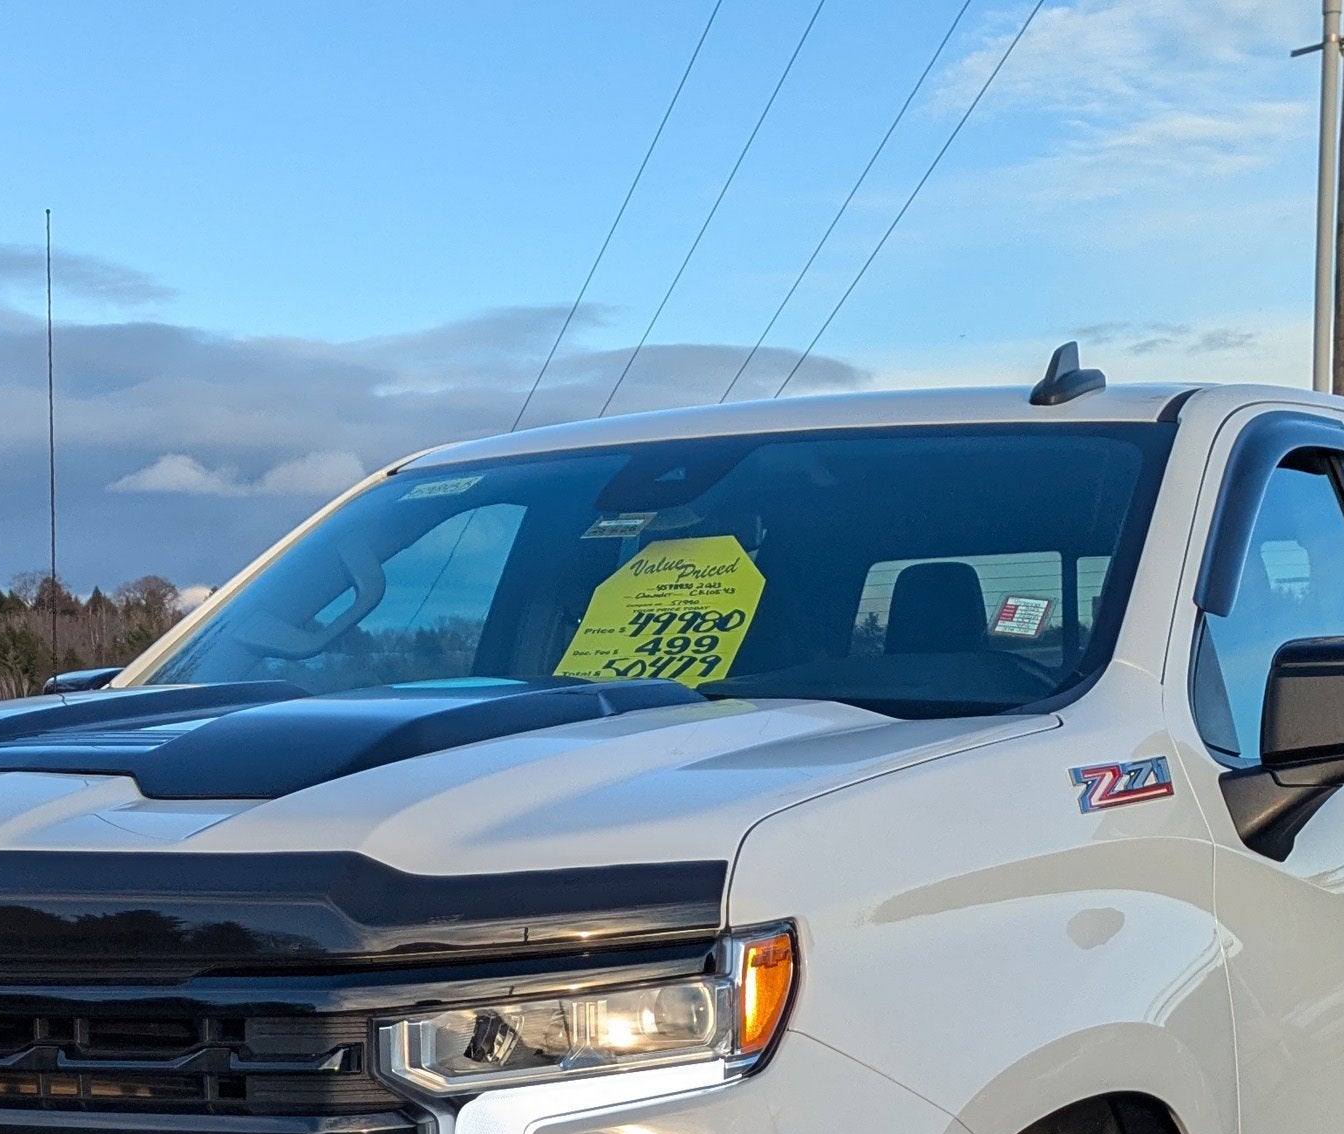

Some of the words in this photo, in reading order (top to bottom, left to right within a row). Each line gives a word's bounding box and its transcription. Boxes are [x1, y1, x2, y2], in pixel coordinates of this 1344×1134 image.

[630, 557, 685, 576] Value
[676, 557, 740, 583] Priced
[584, 626, 615, 635] Price
[628, 609, 746, 637] 49980
[635, 635, 720, 656] 499
[602, 655, 722, 679] 50479
[1067, 756, 1174, 814] Z71
